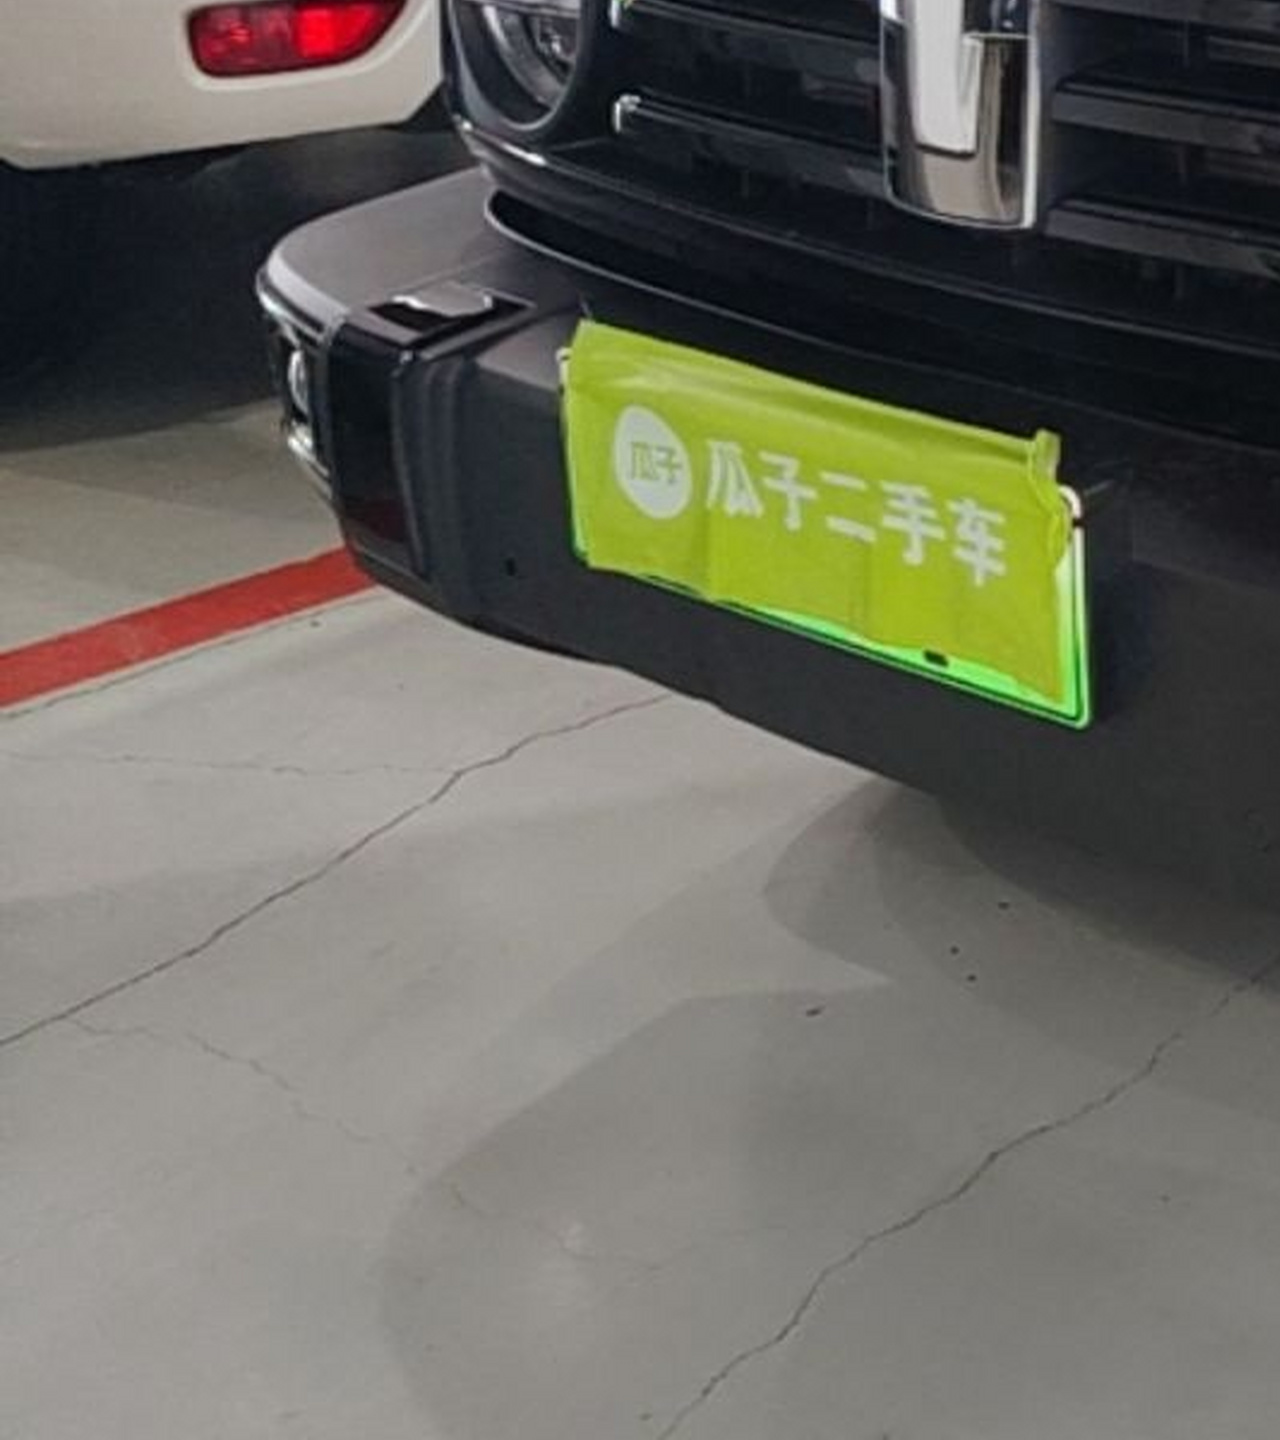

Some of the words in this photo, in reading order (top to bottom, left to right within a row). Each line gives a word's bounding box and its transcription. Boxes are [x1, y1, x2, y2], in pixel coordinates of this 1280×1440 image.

[629, 440, 684, 486] 瓜子
[704, 438, 1008, 589] 瓜子二手车
